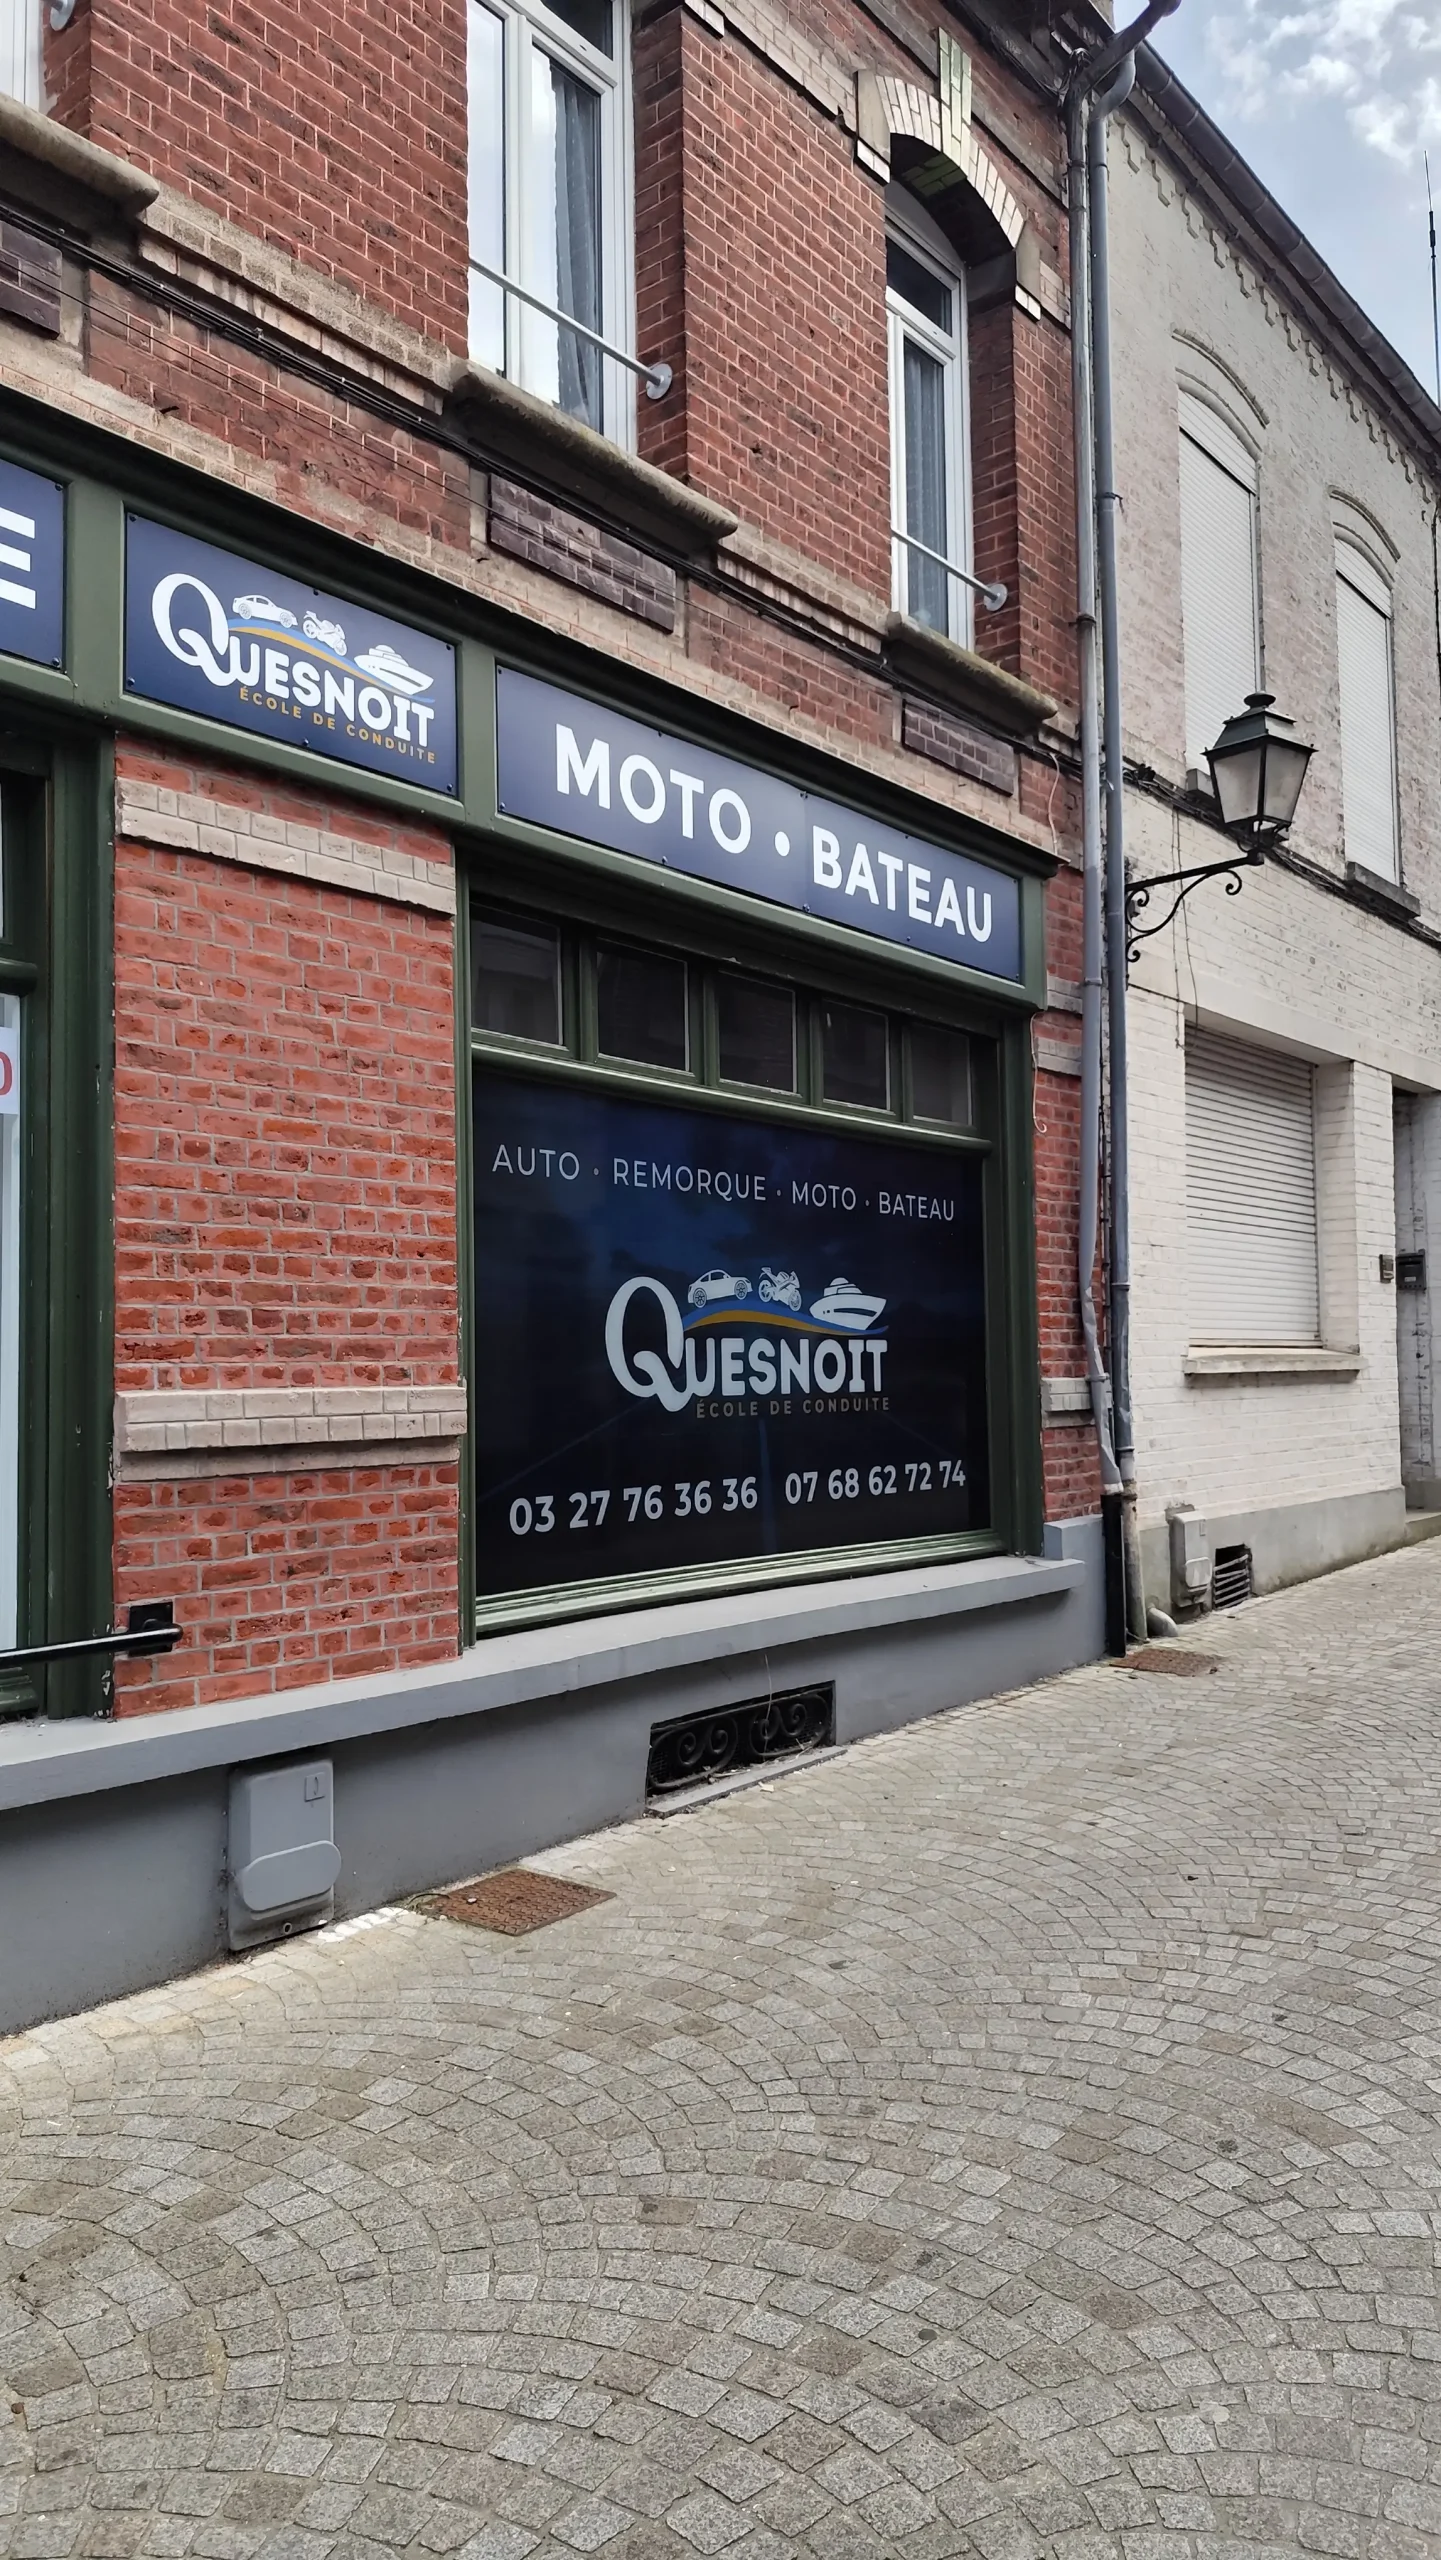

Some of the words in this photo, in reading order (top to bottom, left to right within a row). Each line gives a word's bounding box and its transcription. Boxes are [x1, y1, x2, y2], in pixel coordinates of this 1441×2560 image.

[151, 572, 435, 747] QUESNOIT
[239, 685, 303, 719] ÉCOLE
[313, 713, 336, 730] DE
[346, 724, 436, 764] CONDUITE
[555, 723, 752, 854] MOTO
[811, 824, 993, 943] BATEAU
[492, 1144, 580, 1180] AUTO
[612, 1157, 766, 1202] REMORQUE
[792, 1180, 856, 1211] MOTO
[879, 1191, 955, 1221] BATEAU
[604, 1275, 888, 1413] QUESNOIT
[696, 1399, 759, 1419] ÉCOLE
[770, 1400, 793, 1415] DE
[802, 1396, 890, 1415] CONDUITE
[509, 1496, 556, 1536] 03
[568, 1490, 610, 1530] 27
[623, 1484, 662, 1523] 76
[674, 1480, 711, 1517] 36
[722, 1476, 758, 1513] 36
[785, 1472, 818, 1506] 07
[828, 1468, 860, 1500] 68
[868, 1465, 897, 1496] 62
[905, 1462, 933, 1493] 72
[938, 1459, 967, 1490] 74
